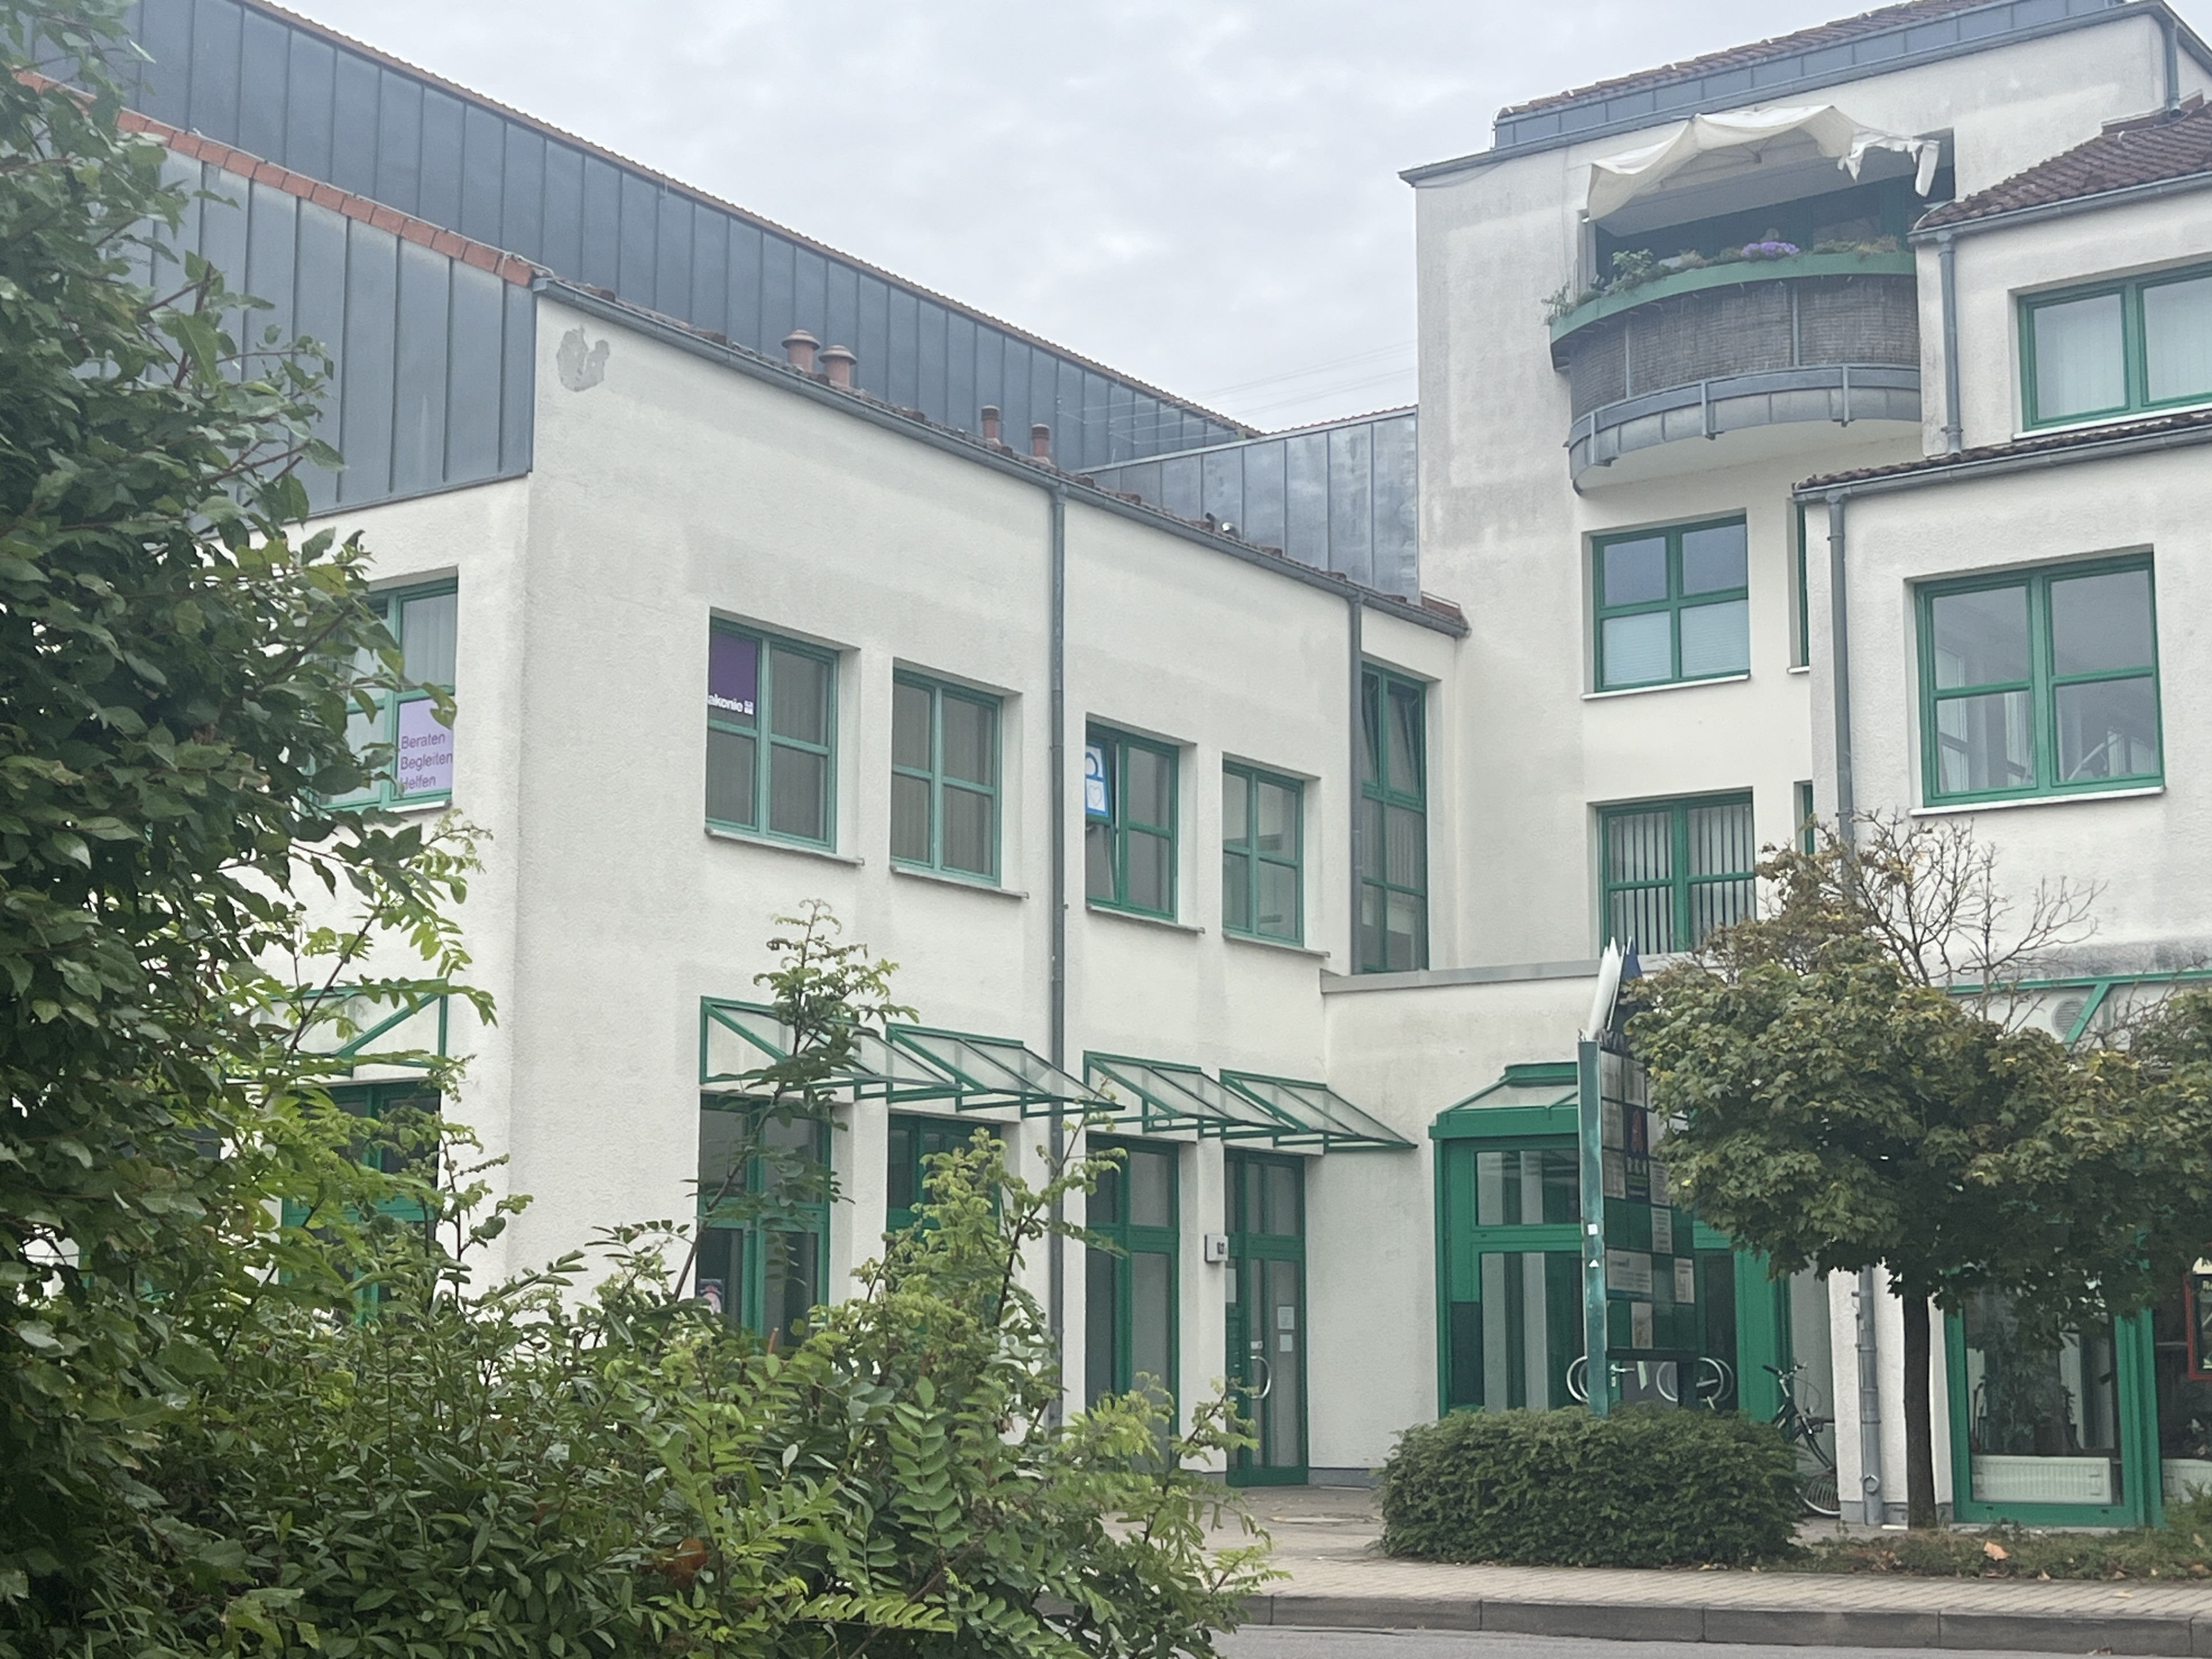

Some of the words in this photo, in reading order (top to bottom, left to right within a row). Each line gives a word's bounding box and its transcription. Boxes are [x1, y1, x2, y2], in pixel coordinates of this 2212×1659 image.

[402, 733, 445, 749] Beraten
[401, 753, 452, 771] Begleiten
[400, 775, 435, 789] Helfen
